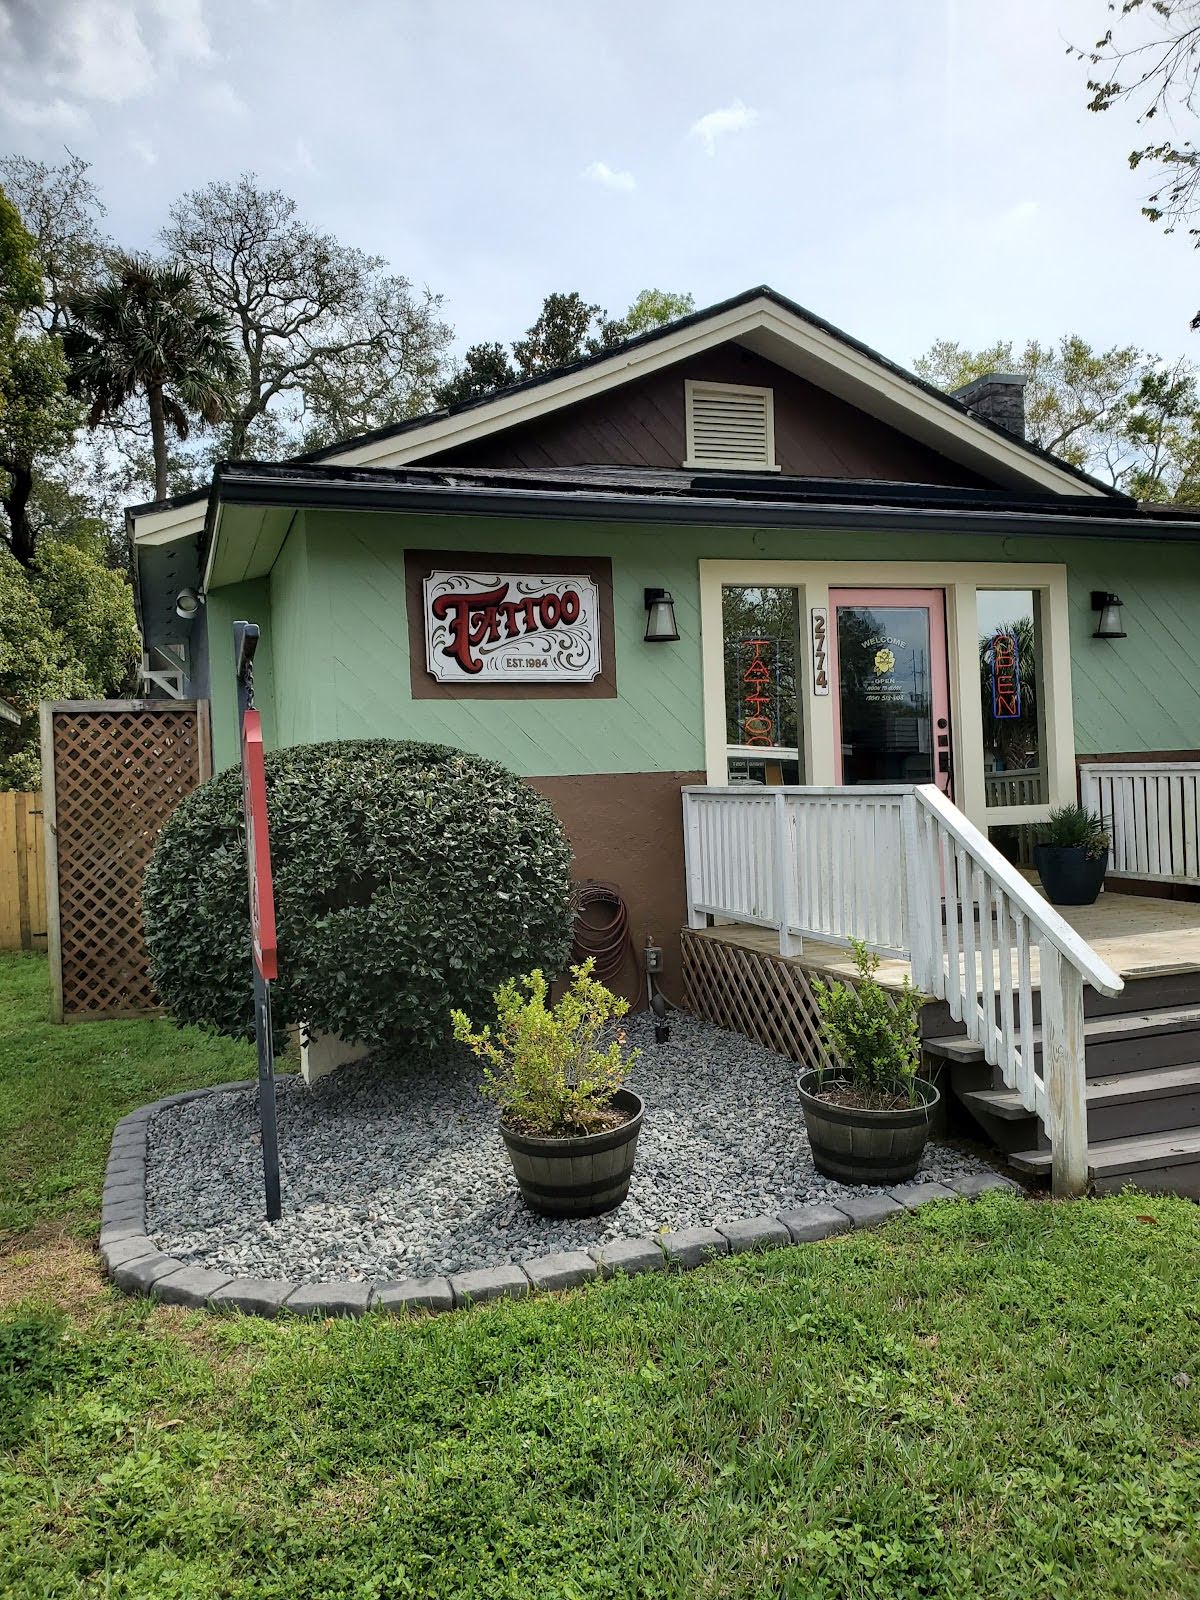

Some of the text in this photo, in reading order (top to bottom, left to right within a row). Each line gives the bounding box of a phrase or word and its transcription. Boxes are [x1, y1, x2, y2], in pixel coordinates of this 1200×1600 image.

[432, 582, 580, 674] TATTOO
[814, 615, 828, 689] 2774
[861, 636, 907, 649] WELCOME
[992, 635, 1017, 716] OPEN
